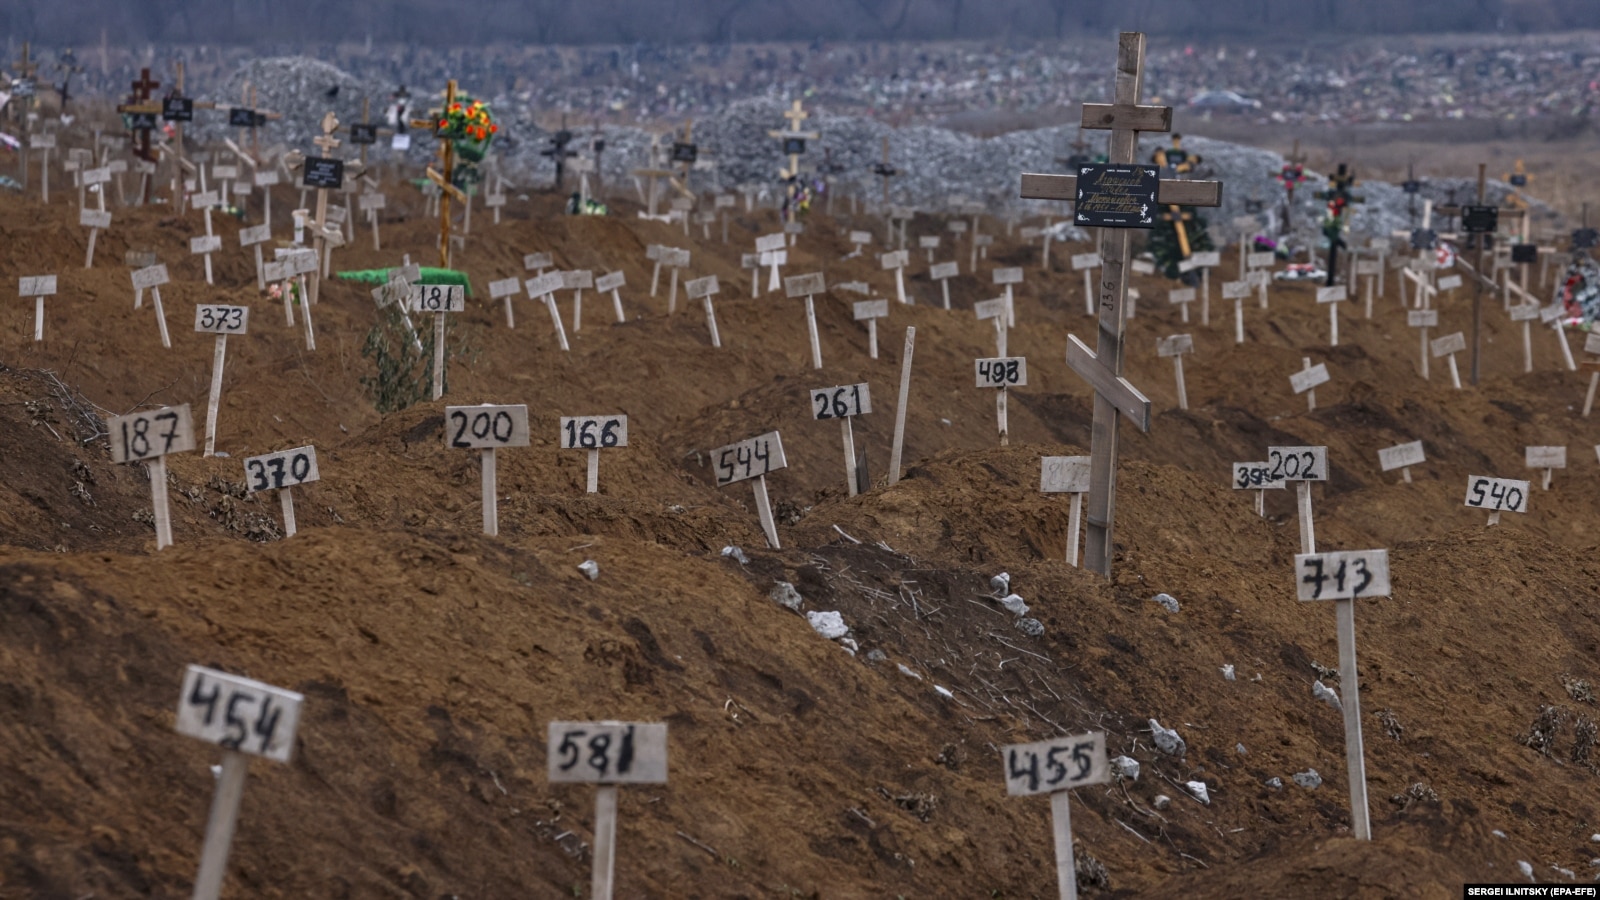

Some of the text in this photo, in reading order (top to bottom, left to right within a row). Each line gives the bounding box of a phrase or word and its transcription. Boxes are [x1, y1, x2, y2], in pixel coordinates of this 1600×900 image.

[420, 285, 453, 311] 181
[1102, 282, 1115, 311] 836
[200, 307, 243, 331] 373
[978, 360, 1019, 384] 498
[814, 386, 862, 418] 261
[121, 411, 181, 460] 187
[450, 409, 514, 447] 200
[565, 418, 621, 448] 166
[248, 452, 311, 491] 370
[717, 440, 770, 483] 544
[1270, 450, 1319, 481] 202
[1467, 479, 1523, 511] 540
[1301, 557, 1372, 600] 713
[188, 673, 281, 753] 454
[556, 724, 635, 778] 581
[1008, 739, 1094, 791] 455
